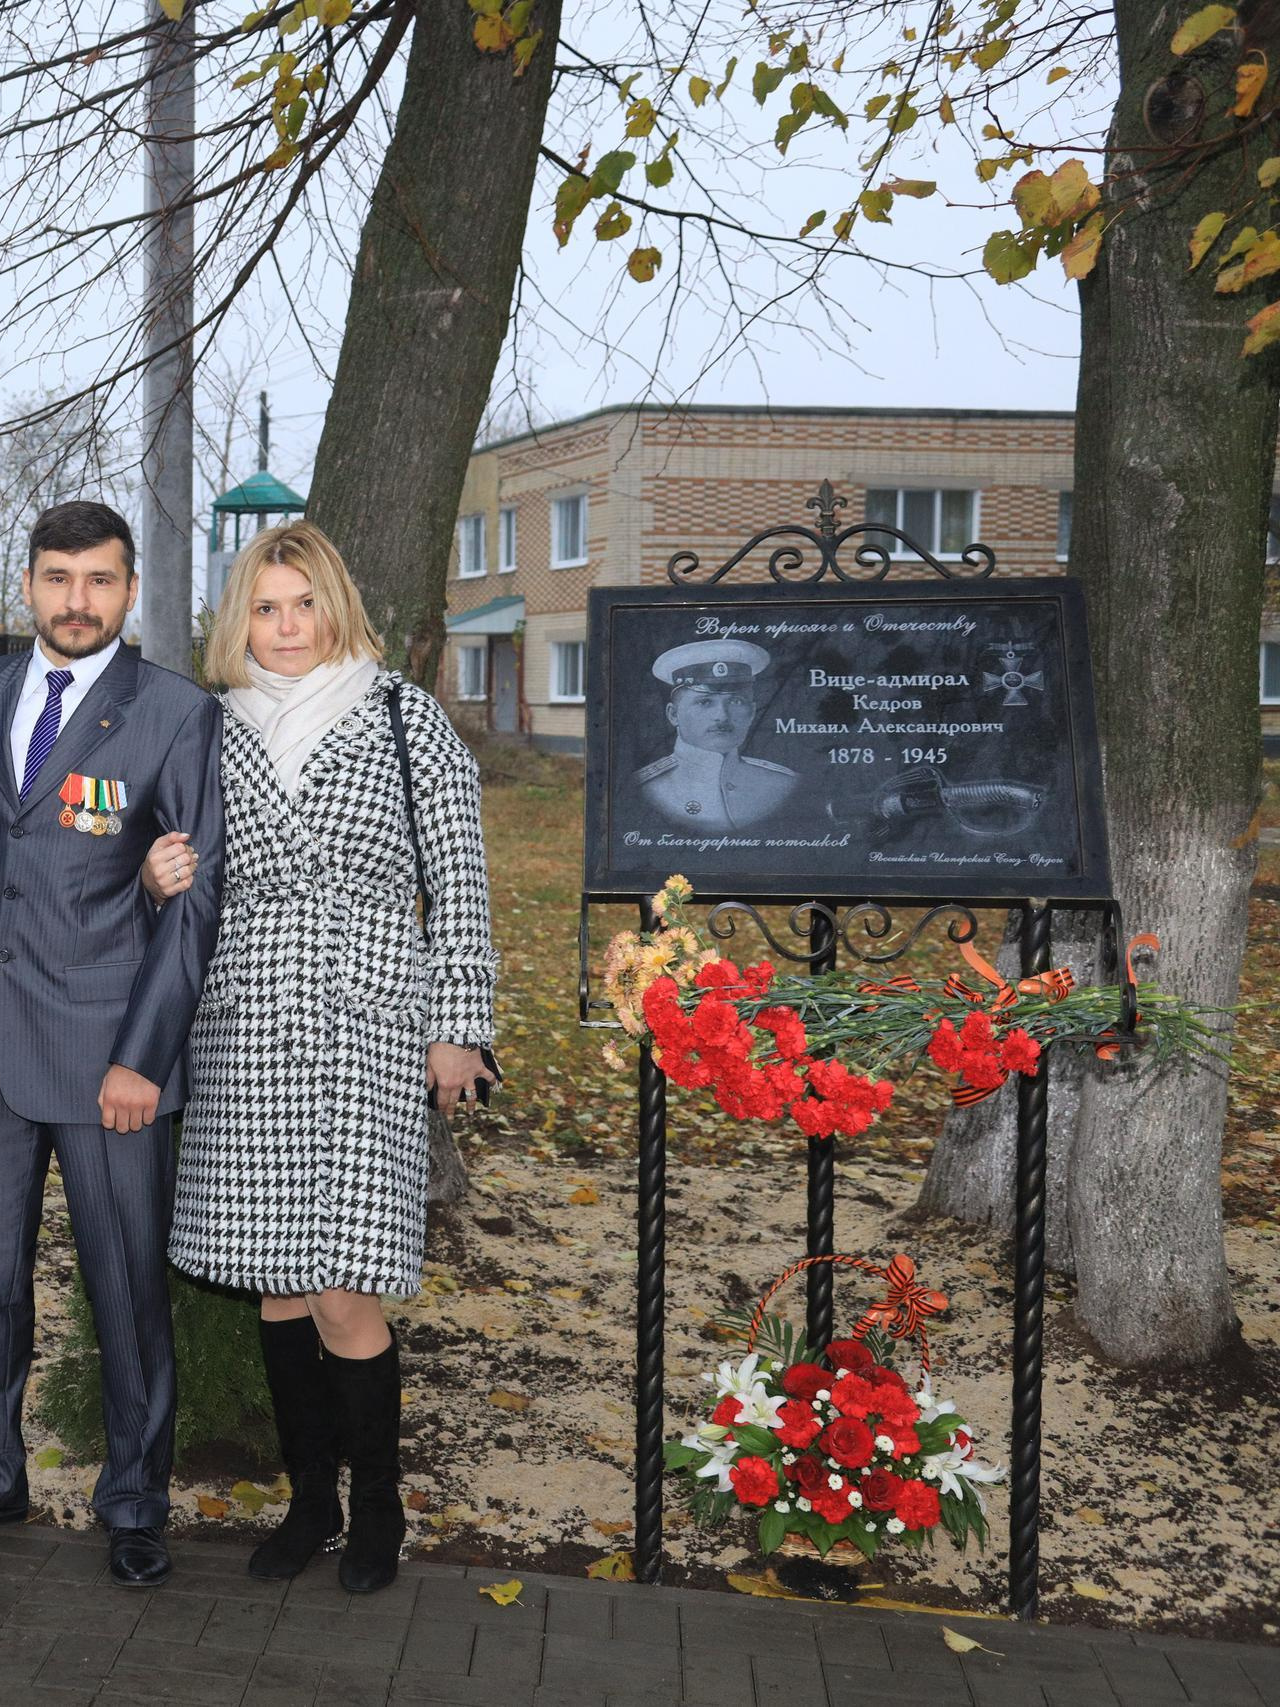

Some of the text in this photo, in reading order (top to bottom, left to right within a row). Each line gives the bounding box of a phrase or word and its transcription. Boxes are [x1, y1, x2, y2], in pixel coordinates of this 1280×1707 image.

[695, 613, 977, 640] Верен присяге и Отечеству
[809, 669, 970, 690] Вице-адмирал
[852, 695, 923, 712] Кедров
[775, 718, 1005, 736] Михаил Александрович
[828, 748, 875, 764] 1878
[901, 748, 948, 764] 1945
[622, 831, 851, 852] От благодарных потомков
